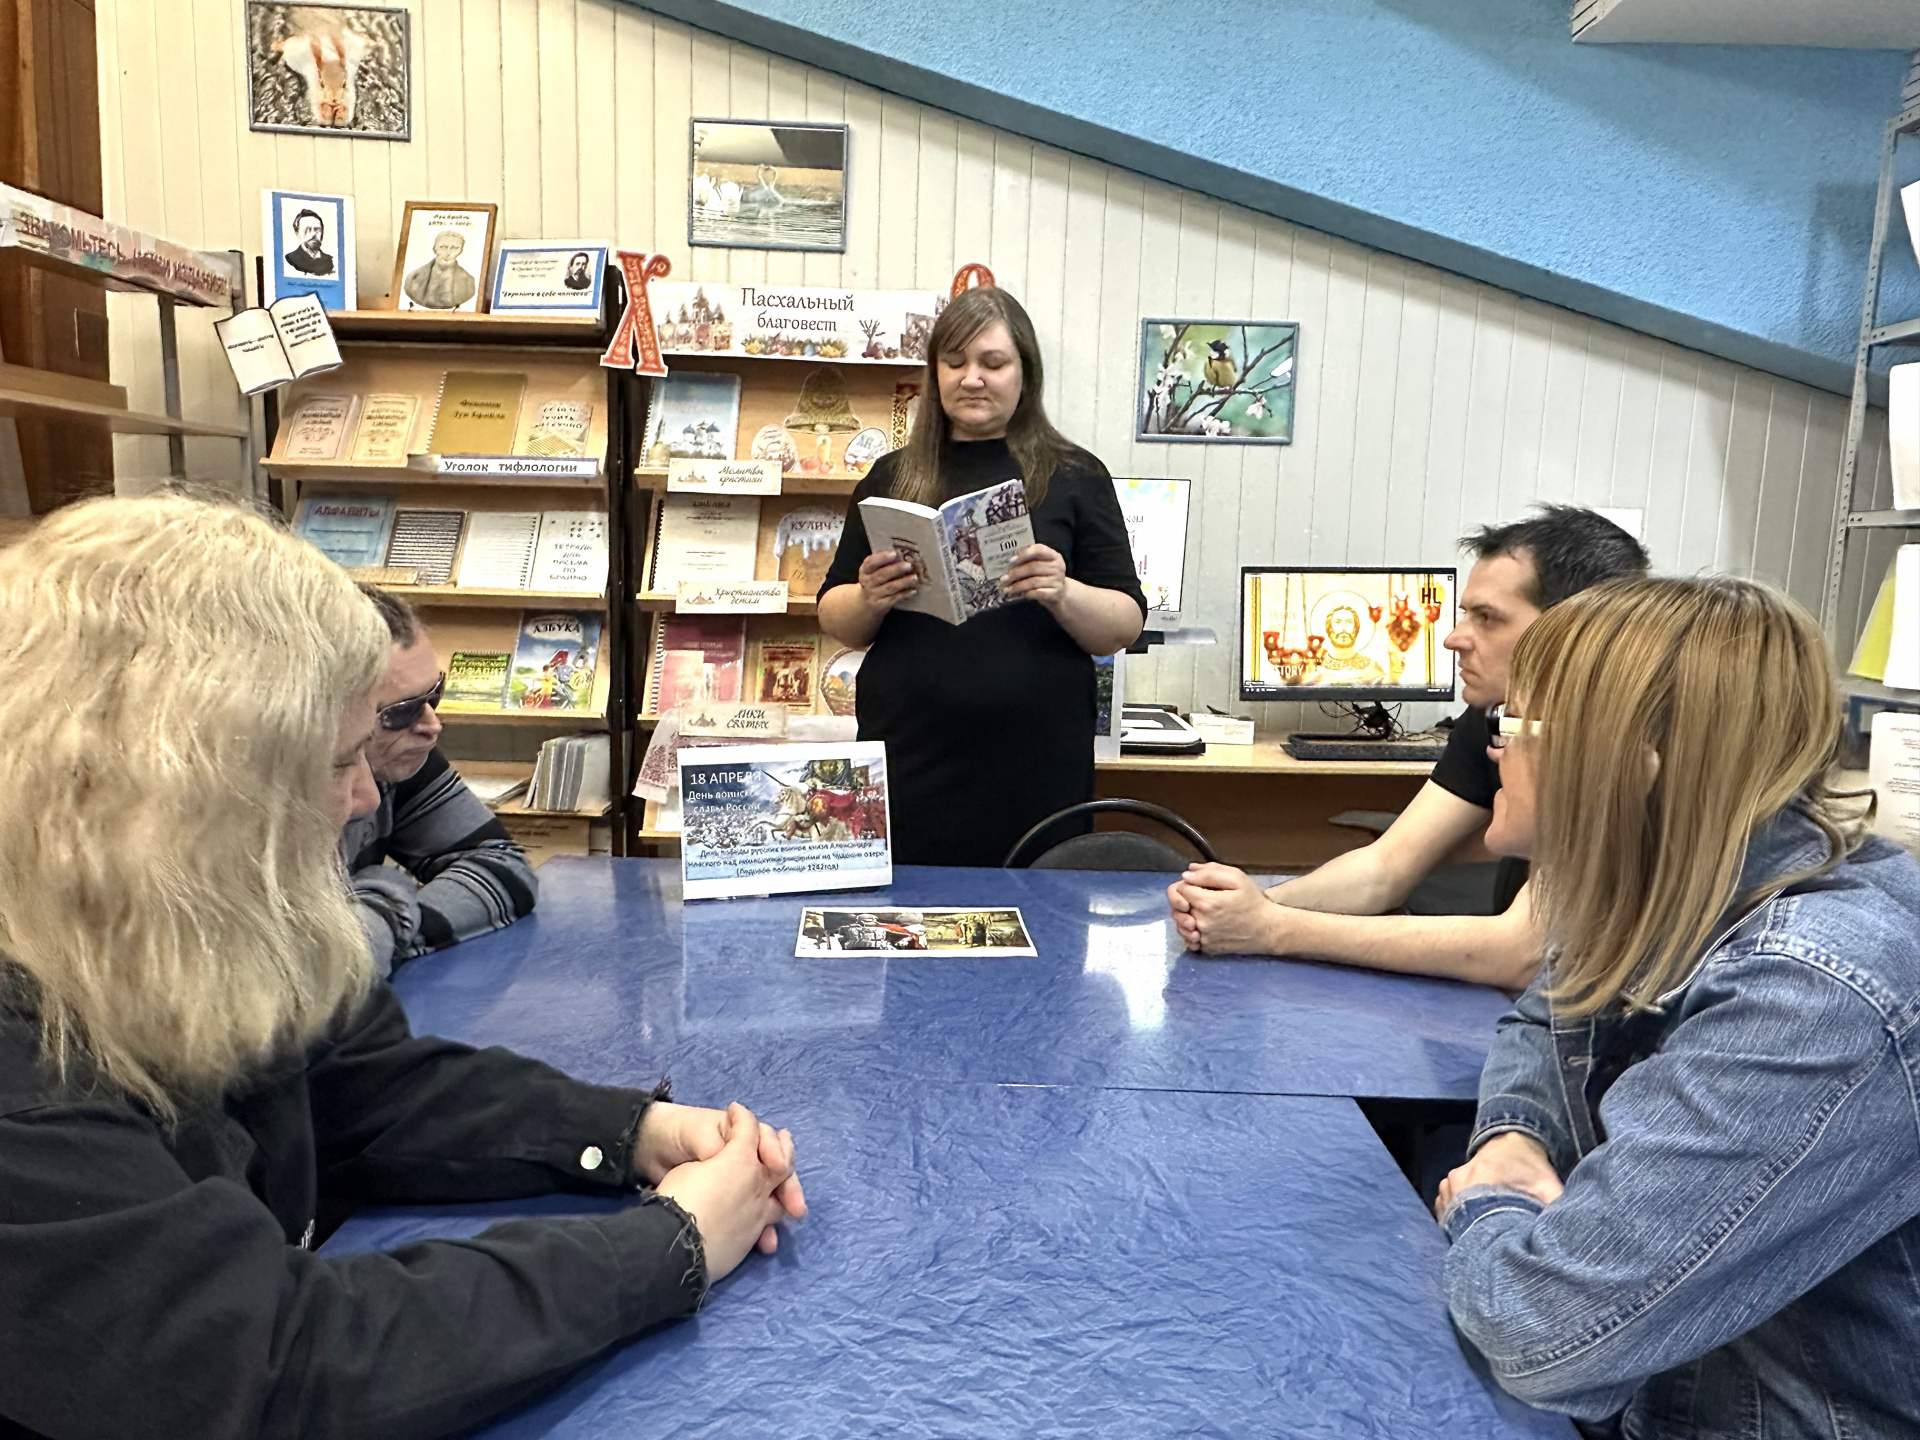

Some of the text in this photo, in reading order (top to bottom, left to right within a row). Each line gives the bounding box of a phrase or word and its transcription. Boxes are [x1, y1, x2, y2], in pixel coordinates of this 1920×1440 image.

[741, 287, 854, 311] Пасхальный
[757, 309, 837, 331] благовест
[444, 461, 578, 473] Уголок тифлологии
[315, 506, 380, 517] АЛФАВИТЫ
[791, 521, 831, 530] КУЛИЧ
[1422, 588, 1441, 604] HL
[533, 623, 580, 633] АЗБУКА
[690, 773, 707, 785] 18
[687, 791, 713, 802] День
